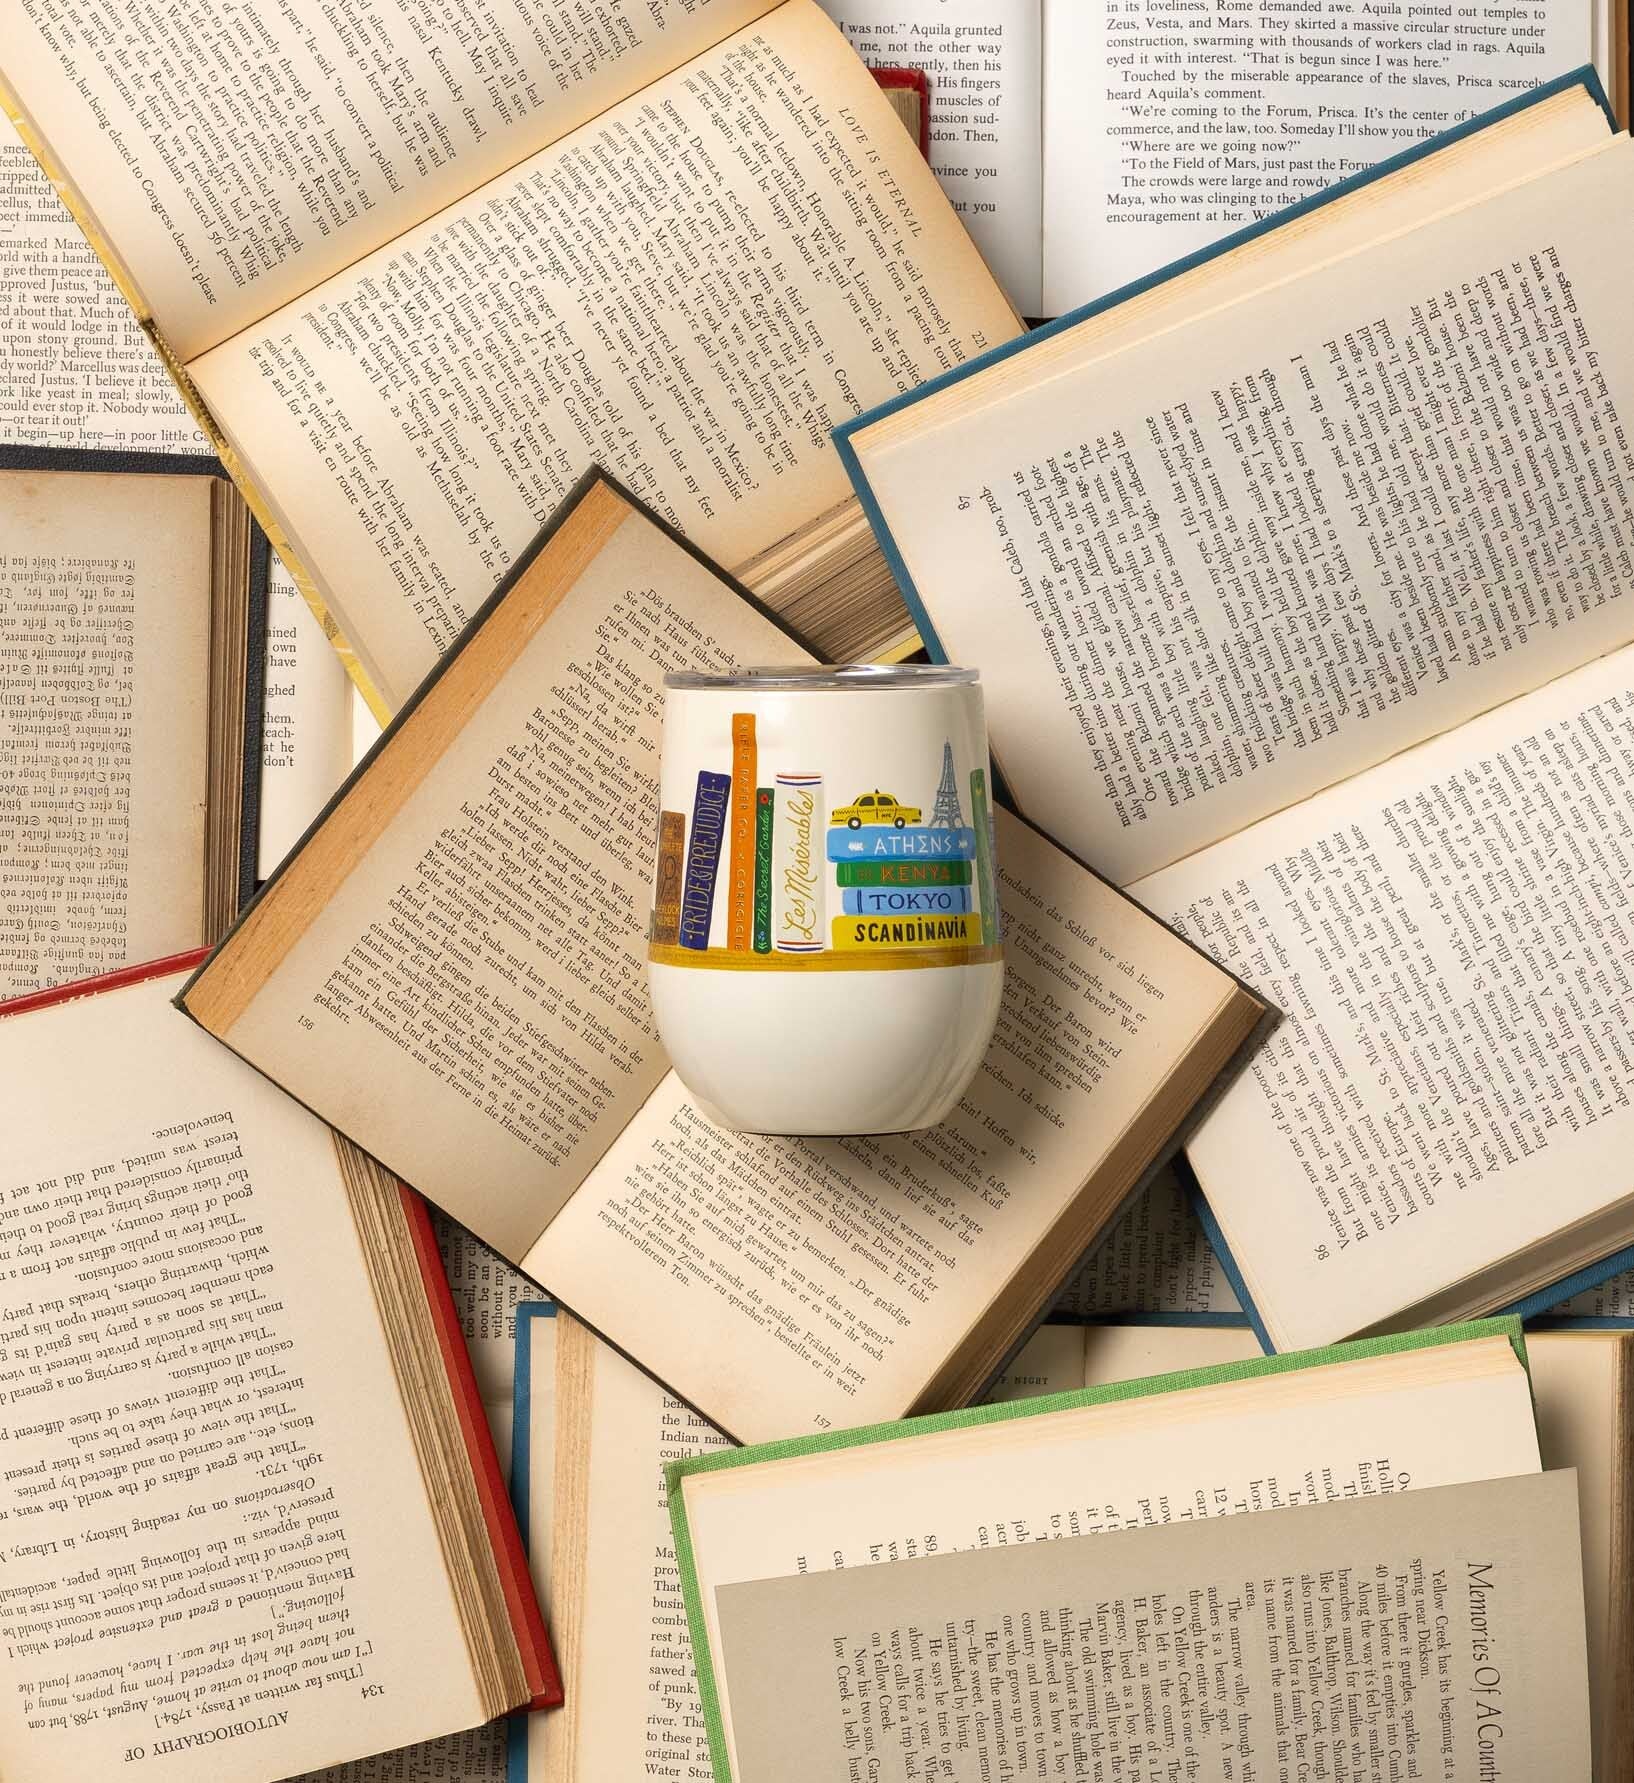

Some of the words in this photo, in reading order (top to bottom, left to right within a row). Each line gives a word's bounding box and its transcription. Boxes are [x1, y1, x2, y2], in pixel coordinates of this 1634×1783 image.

[838, 21, 845, 35] I
[847, 24, 872, 35] was
[909, 22, 952, 39] Aquila
[953, 23, 1003, 39] grunted
[1106, 18, 1140, 31] Zeus,
[1145, 16, 1184, 30] Vesta,
[1188, 16, 1212, 29] and
[1217, 16, 1253, 29] Mars.
[1257, 16, 1290, 32] They
[1294, 17, 1337, 31] skirted
[1340, 21, 1349, 31] a
[1352, 19, 1400, 33] massive
[1403, 20, 1451, 34] circular
[1453, 24, 1508, 37] structure
[1511, 24, 1546, 38] under
[1105, 52, 1135, 69] eyed
[1139, 52, 1149, 65] it
[1153, 51, 1183, 64] with
[1187, 51, 1237, 64] interest.
[1284, 52, 1296, 65] is
[1299, 52, 1336, 68] begun
[1340, 53, 1372, 67] since
[1375, 54, 1381, 67] I
[1385, 57, 1409, 68] was
[936, 75, 959, 89] His
[960, 76, 1002, 92] fingers
[935, 94, 984, 107] muscles
[987, 94, 1003, 107] of
[1106, 87, 1142, 101] heard
[1146, 86, 1200, 103] Aquila's
[1203, 88, 1266, 100] comment.
[1174, 142, 1196, 152] are
[1199, 142, 1218, 152] we
[1221, 138, 1257, 155] going
[38, 21, 63, 53] know
[58, 53, 78, 82] why,
[75, 77, 93, 100] but
[87, 95, 112, 131] being
[107, 129, 139, 167] elected
[131, 165, 144, 180] to
[141, 178, 176, 231] Congress
[171, 231, 201, 273] doesn't
[191, 271, 218, 306] please
[837, 107, 869, 145] LOVE
[864, 149, 882, 164] IS
[876, 168, 923, 238] ETERNAL
[558, 153, 597, 204] Washington
[595, 203, 619, 235] when
[617, 235, 632, 254] we
[626, 255, 646, 275] get
[598, 130, 627, 156] around
[621, 155, 669, 213] Springfield
[662, 217, 701, 270] Abraham
[699, 271, 731, 320] Lincoln
[730, 322, 747, 347] was
[745, 349, 761, 371] the
[0, 317, 14, 330] of
[17, 318, 27, 331] it
[30, 318, 67, 332] would
[71, 318, 103, 335] lodge
[106, 320, 119, 333] in
[123, 318, 145, 333] the
[2, 334, 32, 350] upon
[37, 333, 69, 345] stony
[72, 333, 118, 351] ground.
[123, 333, 145, 347] But
[970, 329, 989, 349] 221
[957, 495, 971, 511] 87
[271, 642, 298, 654] own
[1386, 627, 1403, 654] eyes.
[268, 656, 298, 668] have
[1219, 638, 1246, 691] creatures.
[1395, 654, 1419, 697] different
[0, 692, 26, 706] Bill)
[30, 695, 56, 707] Port
[60, 695, 100, 707] Boston
[104, 694, 133, 708] (The
[1240, 689, 1268, 744] frolicking
[1261, 743, 1276, 764] two
[487, 765, 516, 793] Durst
[758, 809, 772, 850] Garden
[487, 786, 512, 810] Frau
[511, 804, 551, 842] Holstein
[552, 838, 593, 873] verstand
[589, 868, 608, 888] den
[610, 881, 635, 910] Wink.
[783, 789, 819, 901] Misérables
[755, 850, 770, 902] Secret
[880, 863, 951, 883] KENYA
[868, 892, 953, 911] TOKYO
[756, 903, 769, 927] The
[781, 897, 818, 941] Les
[853, 915, 969, 943] SCANDINAVIA
[297, 1014, 315, 1031] 156
[1382, 1111, 1409, 1159] Europe.
[1399, 1157, 1417, 1171] of
[1412, 1171, 1435, 1207] courts
[623, 1175, 641, 1190] nie
[638, 1187, 671, 1215] gehört
[670, 1208, 697, 1237] hatte.
[597, 1210, 668, 1269] respektvollerem
[669, 1262, 690, 1288] Ton.
[1313, 1243, 1331, 1261] 86
[813, 1413, 832, 1430] 157
[255, 1461, 289, 1479] 1731.
[291, 1452, 325, 1472] 19th,
[1187, 1589, 1208, 1638] through
[1467, 1561, 1497, 1663] Memories
[649, 1646, 693, 1661] father's
[1193, 1639, 1209, 1660] the
[304, 1675, 324, 1690] far
[648, 1679, 662, 1692] of
[663, 1680, 697, 1696] punk.
[1195, 1662, 1211, 1698] entire
[1469, 1665, 1503, 1697] Of
[237, 1694, 252, 1708] at
[254, 1682, 302, 1701] written
[360, 1683, 386, 1700] 134
[195, 1698, 236, 1715] Passy,
[1475, 1699, 1504, 1722] A
[1197, 1700, 1216, 1740] valley.
[152, 1710, 289, 1757] AUTOBIOGRAPHY
[123, 1746, 146, 1763] OF
